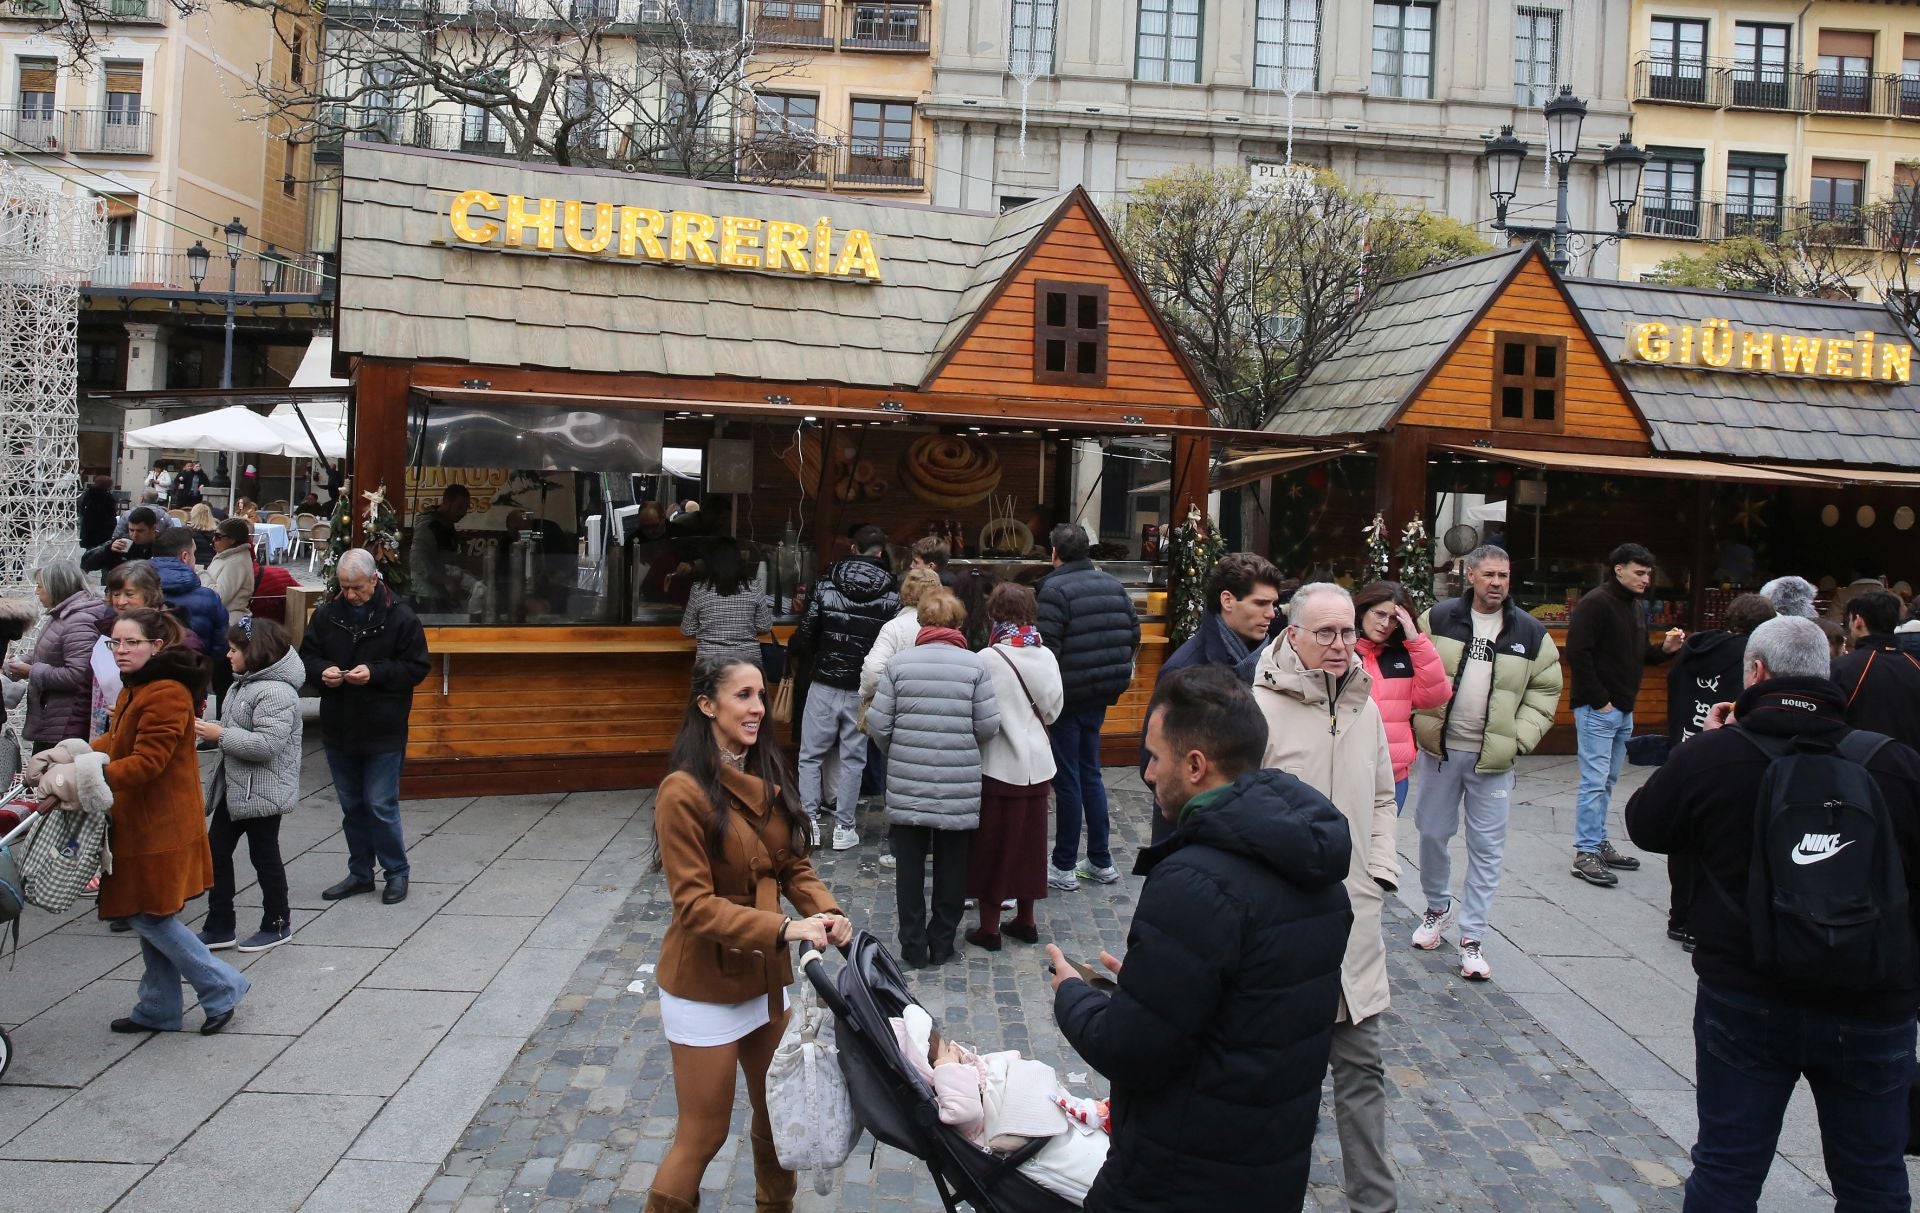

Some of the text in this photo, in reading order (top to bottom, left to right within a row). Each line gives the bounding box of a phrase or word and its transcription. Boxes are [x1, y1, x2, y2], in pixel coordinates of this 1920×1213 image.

[450, 189, 881, 279] CHURRERÍA
[1781, 697, 1818, 712] Canon
[1800, 833, 1841, 852] NIKE
